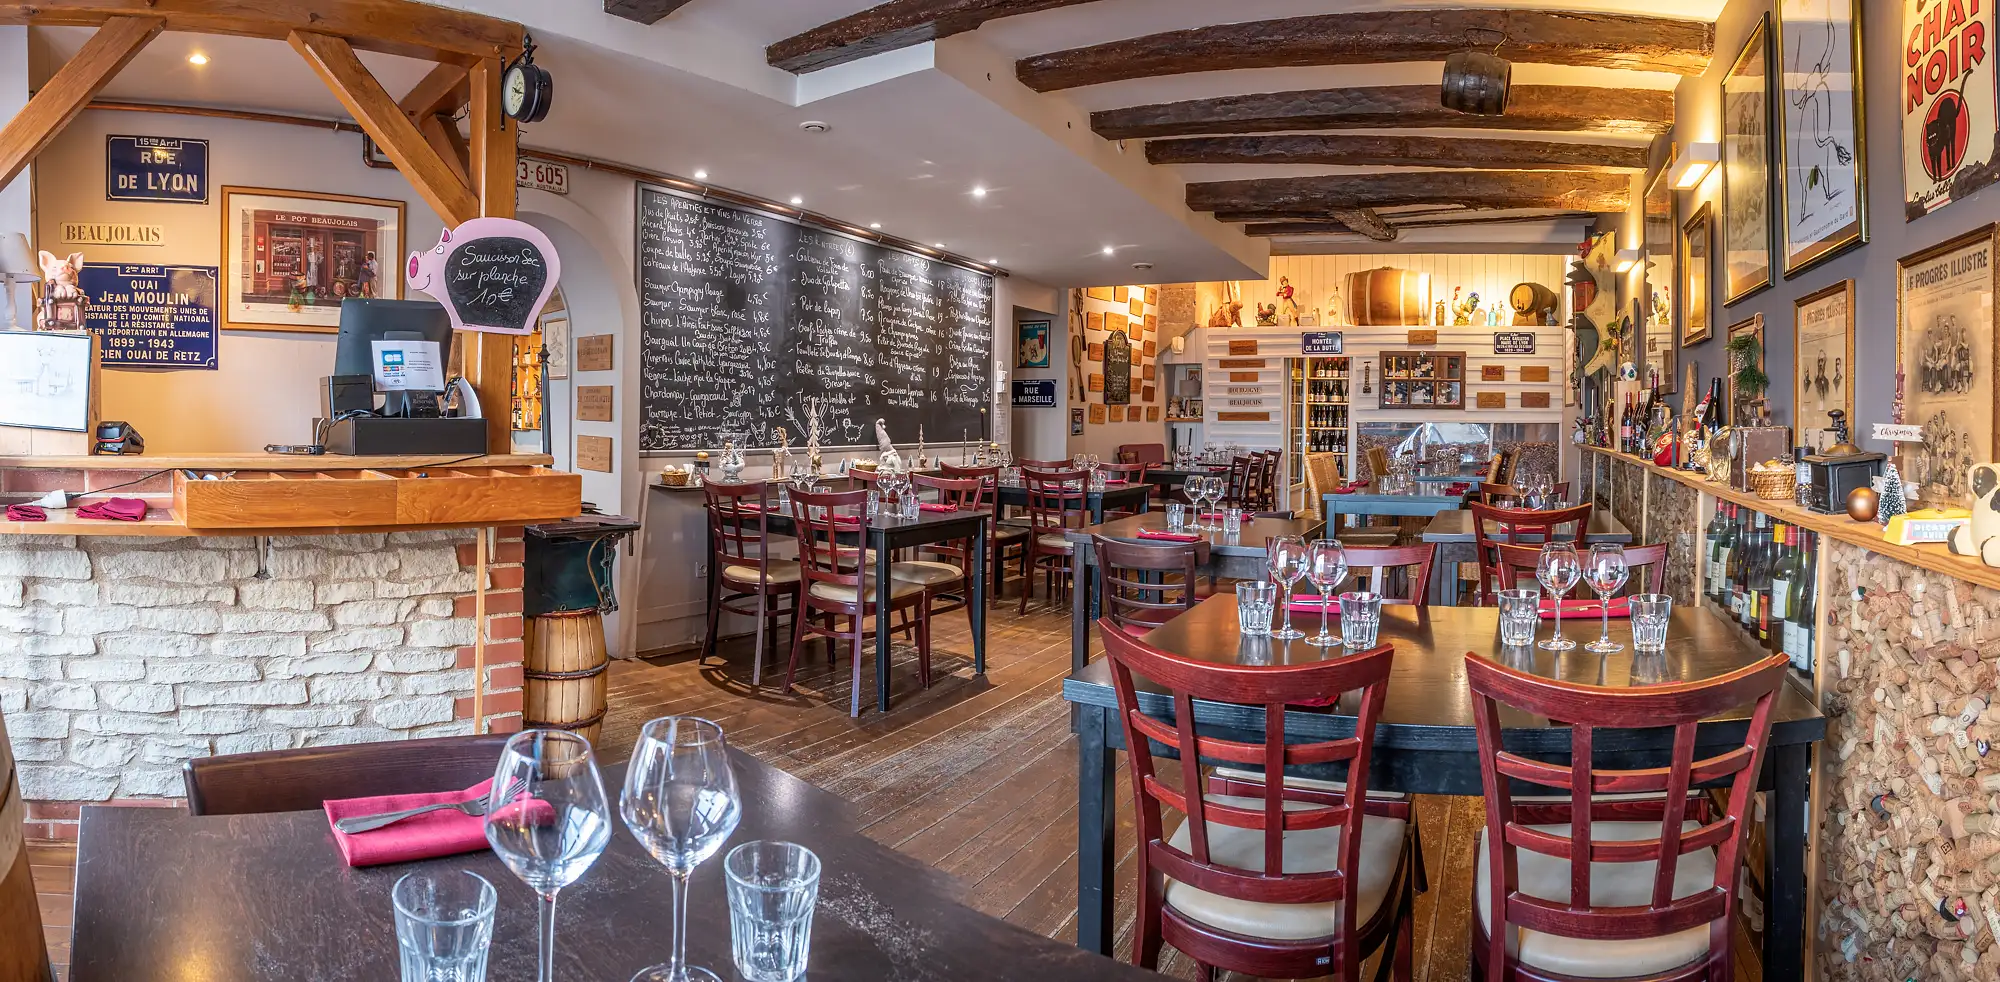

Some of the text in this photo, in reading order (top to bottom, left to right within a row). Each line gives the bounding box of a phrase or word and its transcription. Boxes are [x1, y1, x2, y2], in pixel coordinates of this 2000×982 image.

[1907, 20, 1986, 115] NOIR
[141, 151, 175, 165] RUE
[518, 162, 563, 186] 3-605
[118, 172, 197, 192] DE LYON
[312, 217, 358, 226] BEAUJOLAIS
[65, 225, 160, 243] BEAUJOLAIS
[462, 246, 540, 267] Saucisson Sec
[453, 266, 528, 288] sur planche
[131, 280, 157, 291] QUAI
[134, 291, 188, 306] MOULIN
[467, 288, 513, 306] 10€
[130, 306, 177, 315] MOUVEMENTS
[180, 308, 195, 316] UNIS
[132, 314, 141, 322] DU
[170, 331, 209, 339] ALLEMAGNE
[110, 338, 175, 350] 1899 1943
[127, 350, 151, 361] QUAI
[156, 352, 168, 361] DE
[174, 352, 200, 363] RETZ
[1024, 386, 1039, 395] RUE
[1019, 395, 1053, 403] MARSEILLE
[1880, 428, 1912, 437] Christmas
